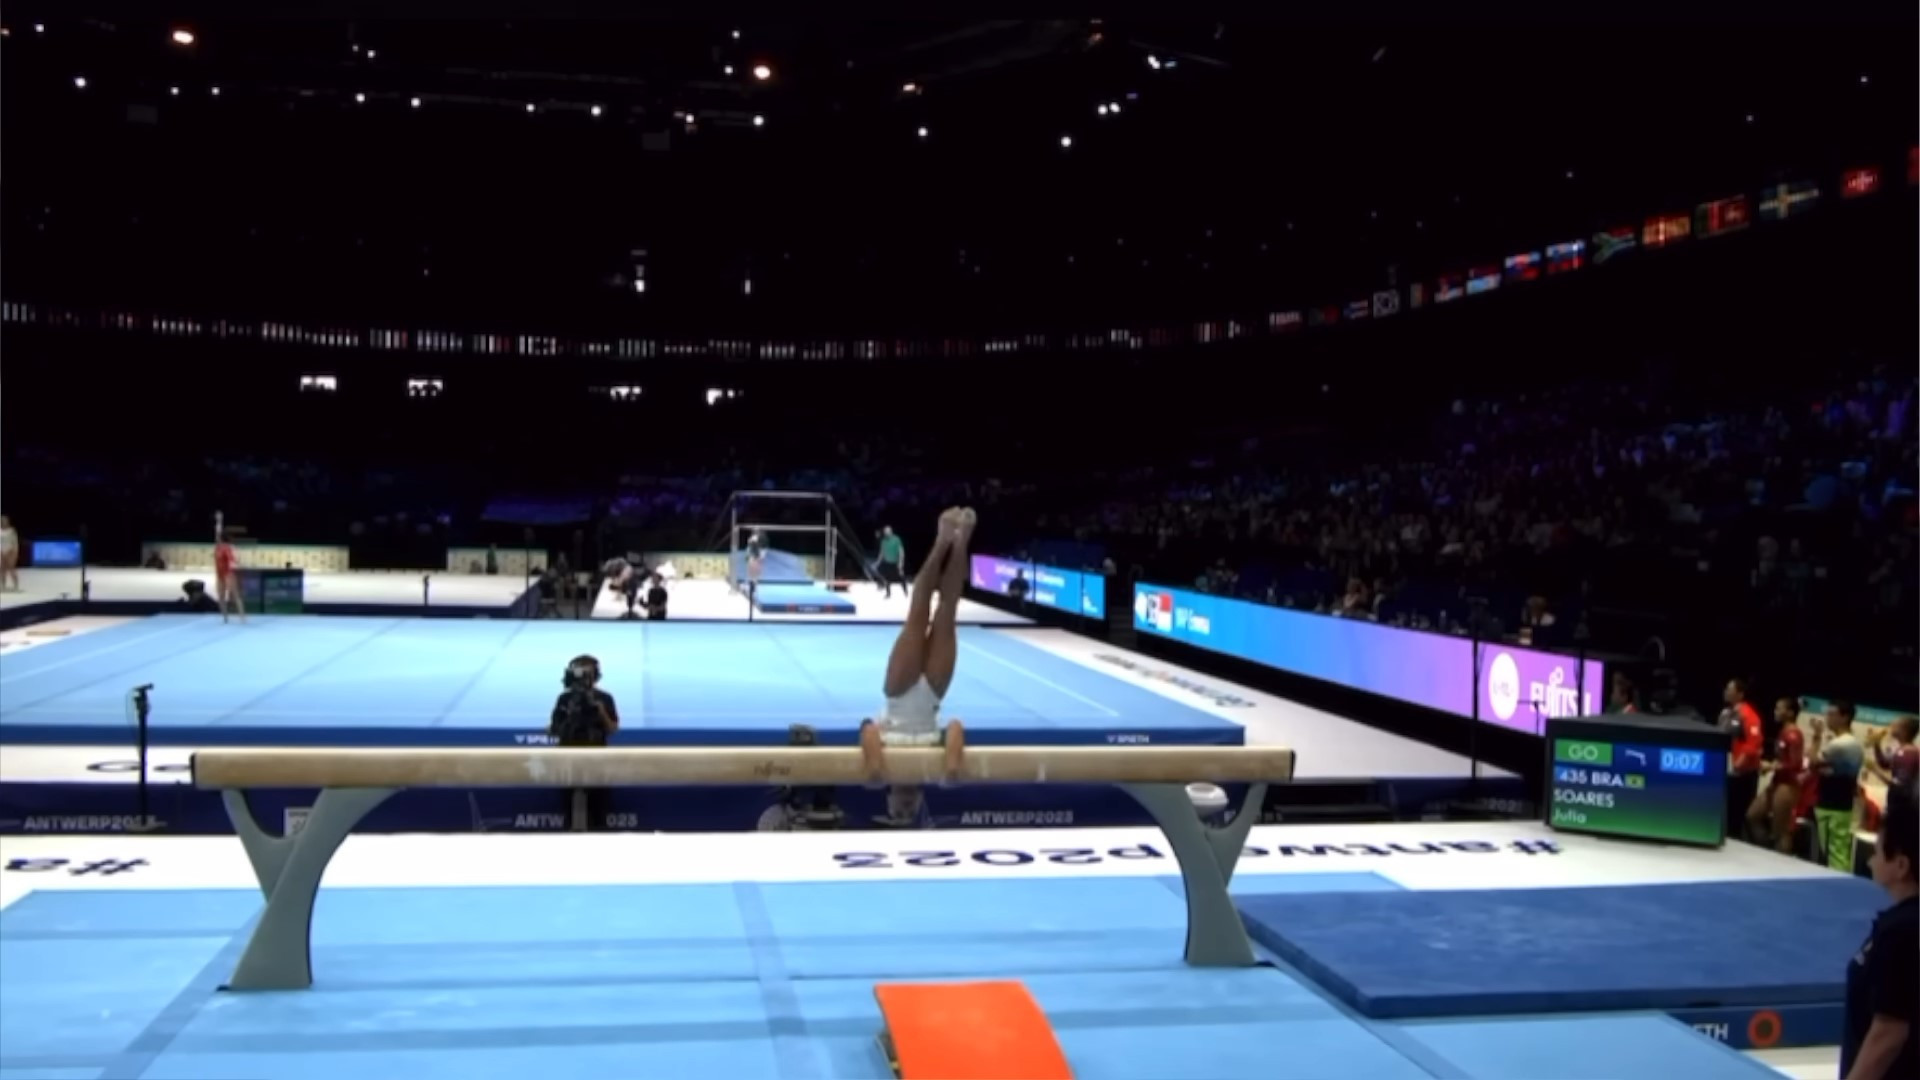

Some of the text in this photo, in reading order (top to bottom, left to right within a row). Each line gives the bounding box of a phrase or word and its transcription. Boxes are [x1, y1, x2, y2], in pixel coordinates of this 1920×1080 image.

[1568, 744, 1599, 761] GO
[1662, 752, 1701, 770] 0:07
[1559, 768, 1624, 787] 435 BRA
[1554, 789, 1615, 809] SOARES
[960, 810, 1074, 825] ANTWERP2023
[1554, 808, 1588, 824] Julia
